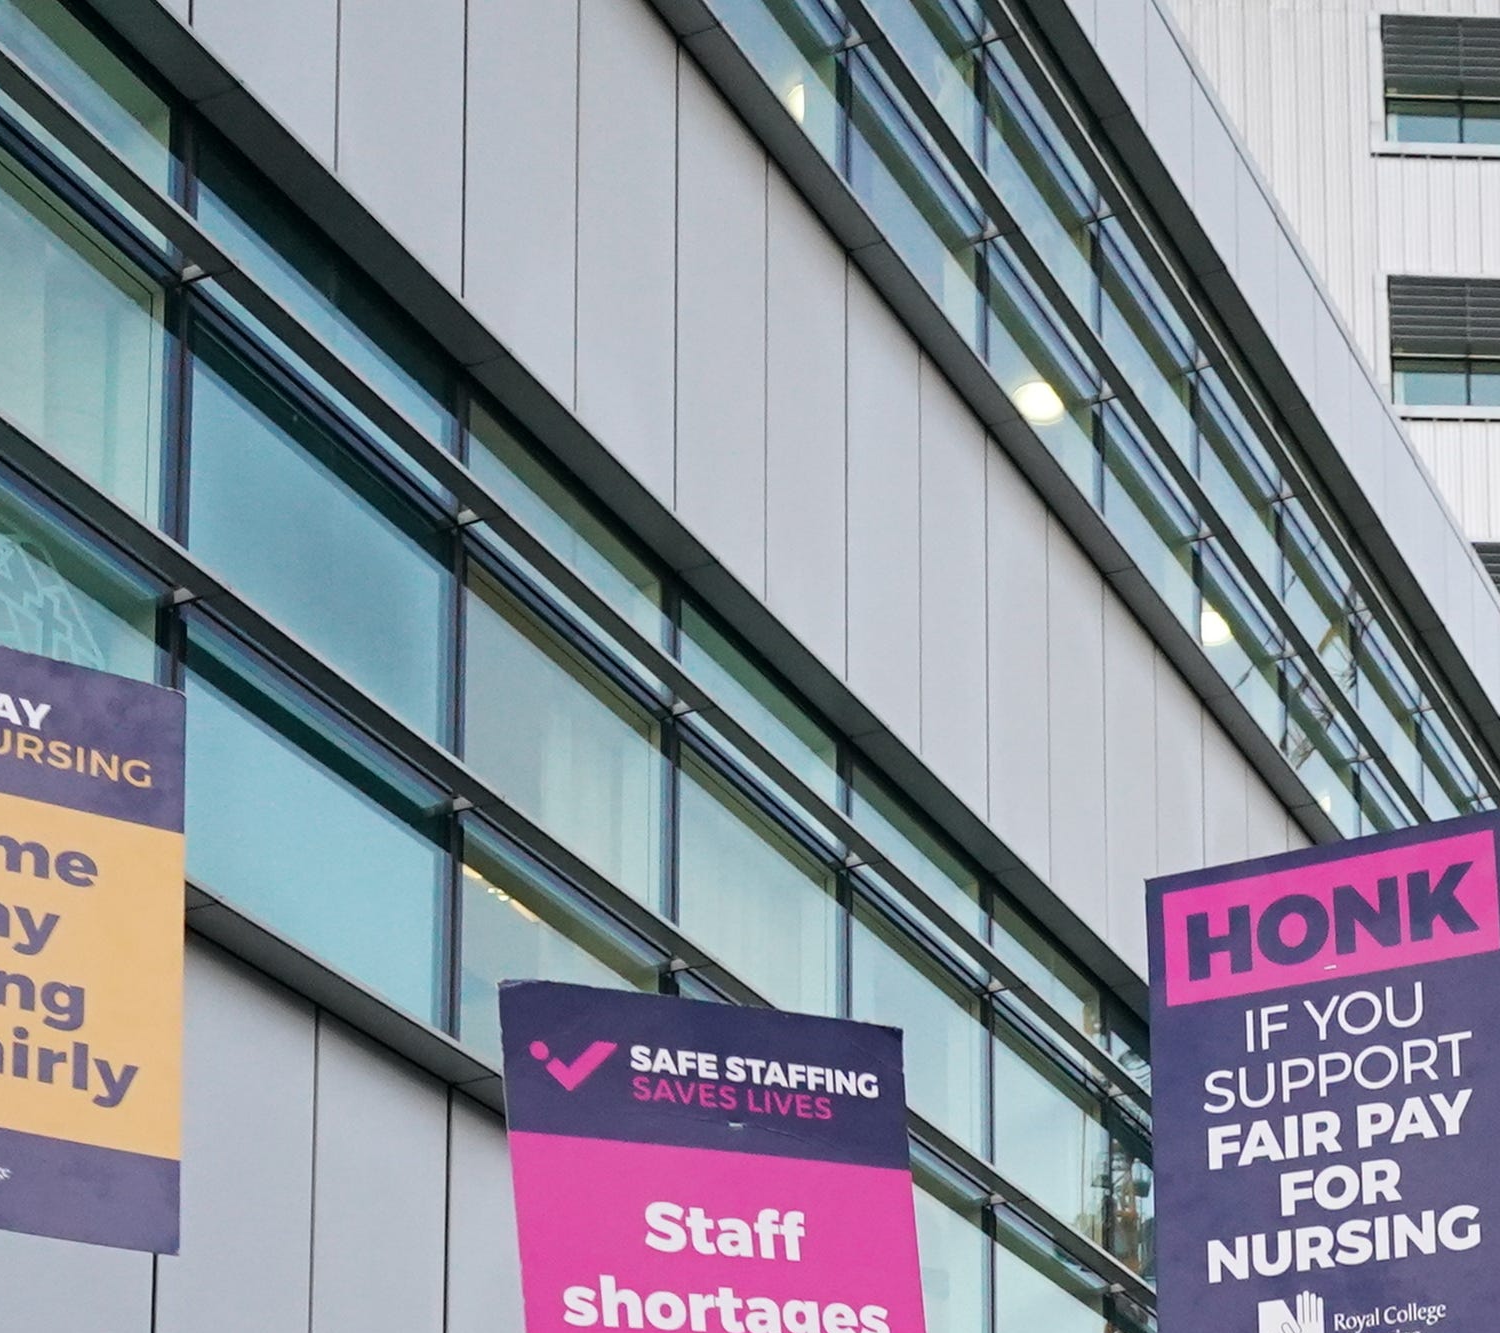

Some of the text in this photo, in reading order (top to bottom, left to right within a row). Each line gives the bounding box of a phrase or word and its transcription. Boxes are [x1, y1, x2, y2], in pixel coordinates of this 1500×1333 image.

[1186, 861, 1480, 982] HONK
[1244, 981, 1423, 1053] IF YOU
[630, 1043, 880, 1098] SAFE STAFFING
[631, 1076, 833, 1121] SAVES LIVES
[1203, 1030, 1473, 1115] SUPPORT
[1207, 1088, 1473, 1170] FAIR PAY
[1279, 1158, 1403, 1217] FOR
[643, 1200, 807, 1262] Staff
[1206, 1204, 1482, 1284] NURSING
[1383, 1301, 1447, 1326] College
